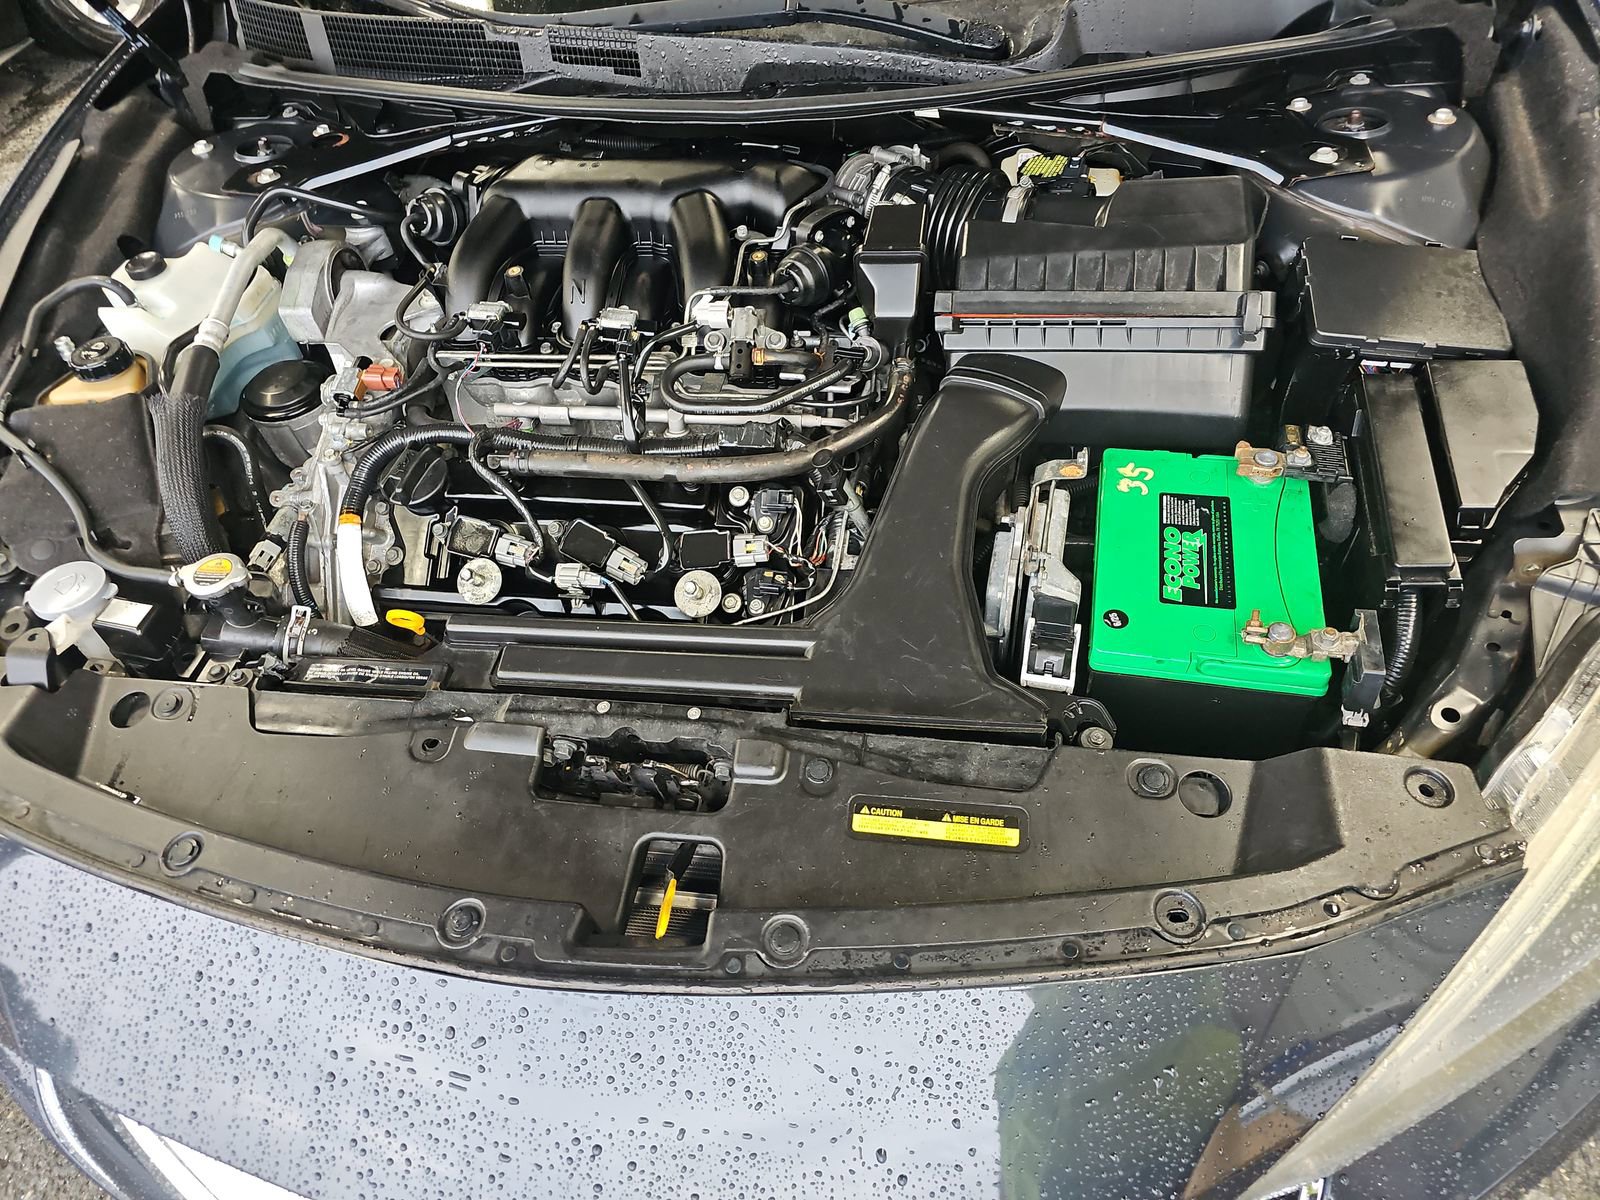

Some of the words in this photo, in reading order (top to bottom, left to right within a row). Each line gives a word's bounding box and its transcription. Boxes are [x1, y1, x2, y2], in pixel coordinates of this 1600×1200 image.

[1116, 462, 1154, 496] 35
[1162, 526, 1182, 602] ECONO
[1181, 530, 1202, 590] POWER
[870, 807, 903, 818] CAUTION
[952, 815, 969, 824] MISE
[969, 816, 980, 825] EN
[980, 817, 1005, 827] GARDE
